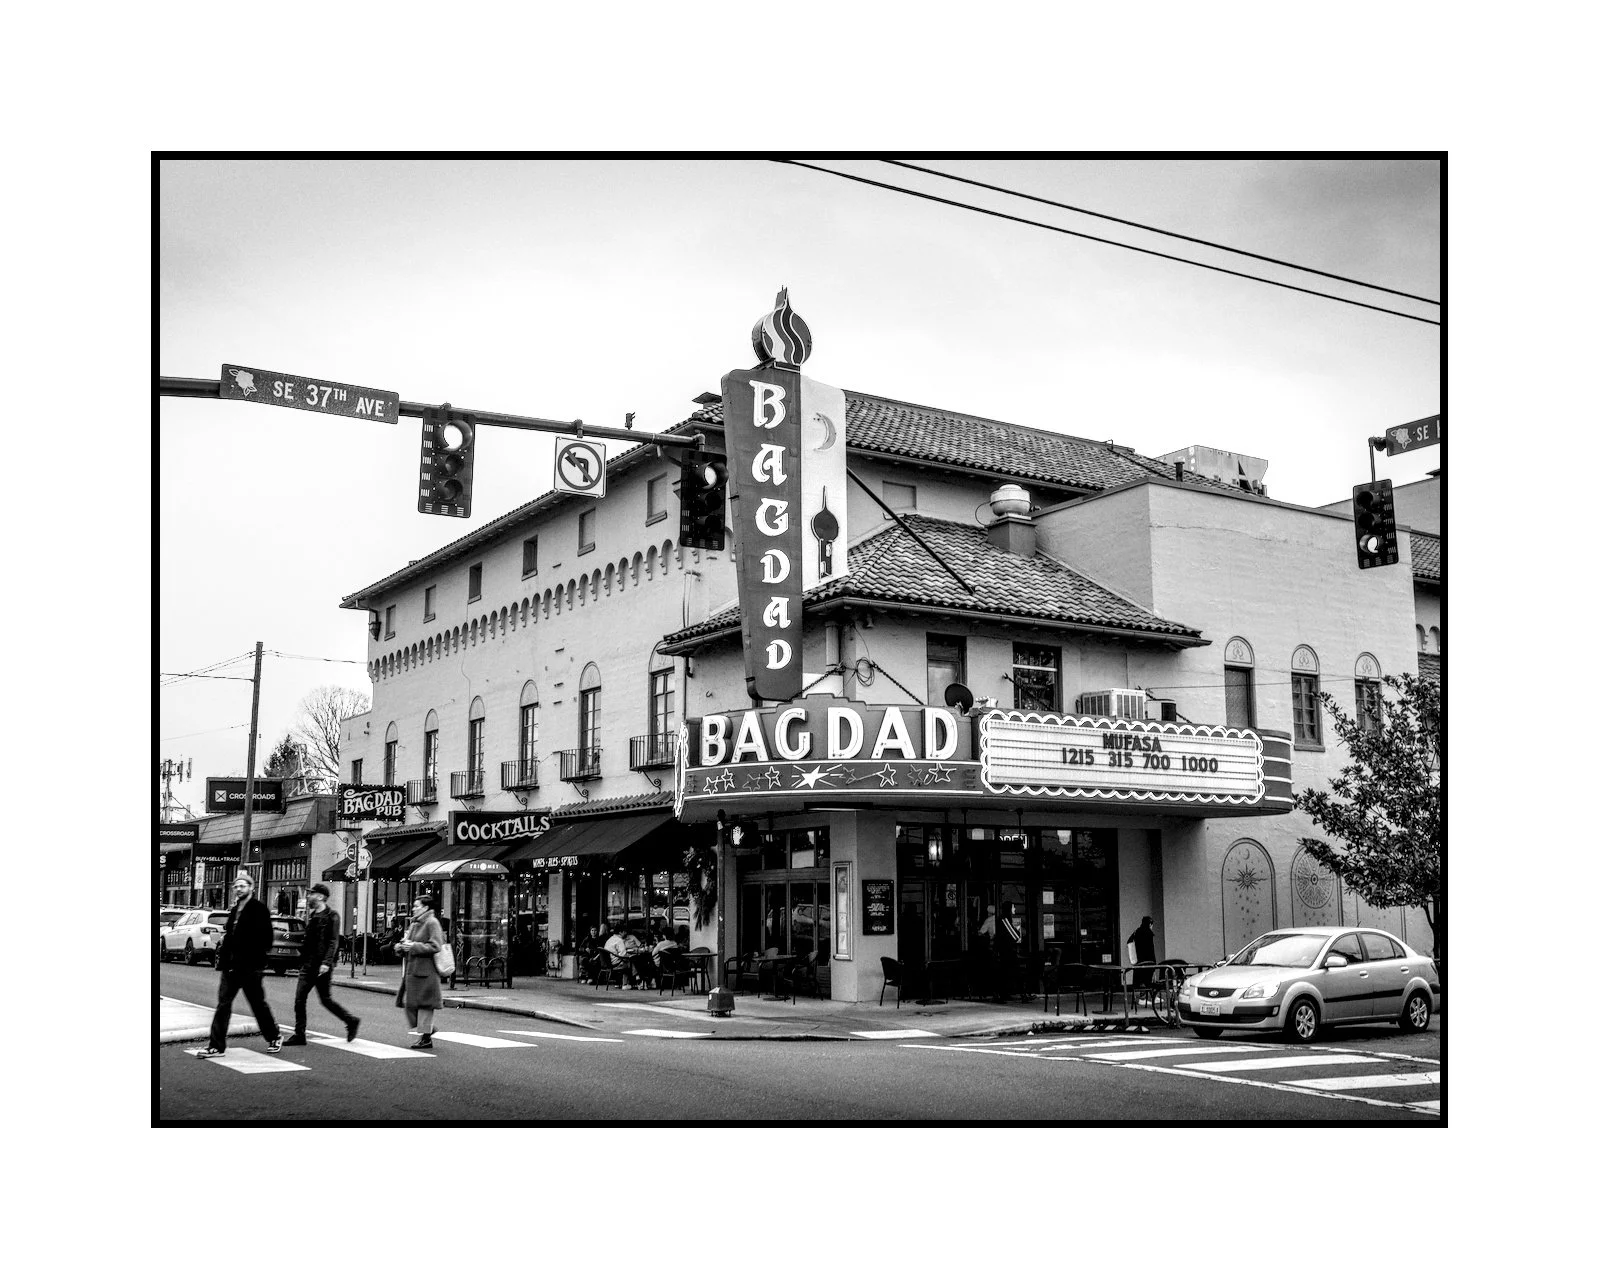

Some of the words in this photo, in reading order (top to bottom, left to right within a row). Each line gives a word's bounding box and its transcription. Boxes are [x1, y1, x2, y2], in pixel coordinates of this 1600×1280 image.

[273, 380, 294, 400] SE
[305, 384, 347, 408] 37TH
[356, 397, 385, 417] AVE
[1416, 424, 1430, 442] SE
[748, 379, 793, 670] BAGDAD
[701, 706, 958, 767] BAGDAD
[1102, 733, 1163, 753] MUFASA
[1062, 747, 1095, 765] 1215
[1108, 751, 1134, 768] 315
[1142, 753, 1171, 770] 700
[1181, 755, 1219, 773] 1000
[228, 792, 276, 801] CROSROADS
[343, 790, 403, 815] BAGDAD
[376, 805, 402, 817] PUB
[456, 816, 550, 840] COCKTAILS
